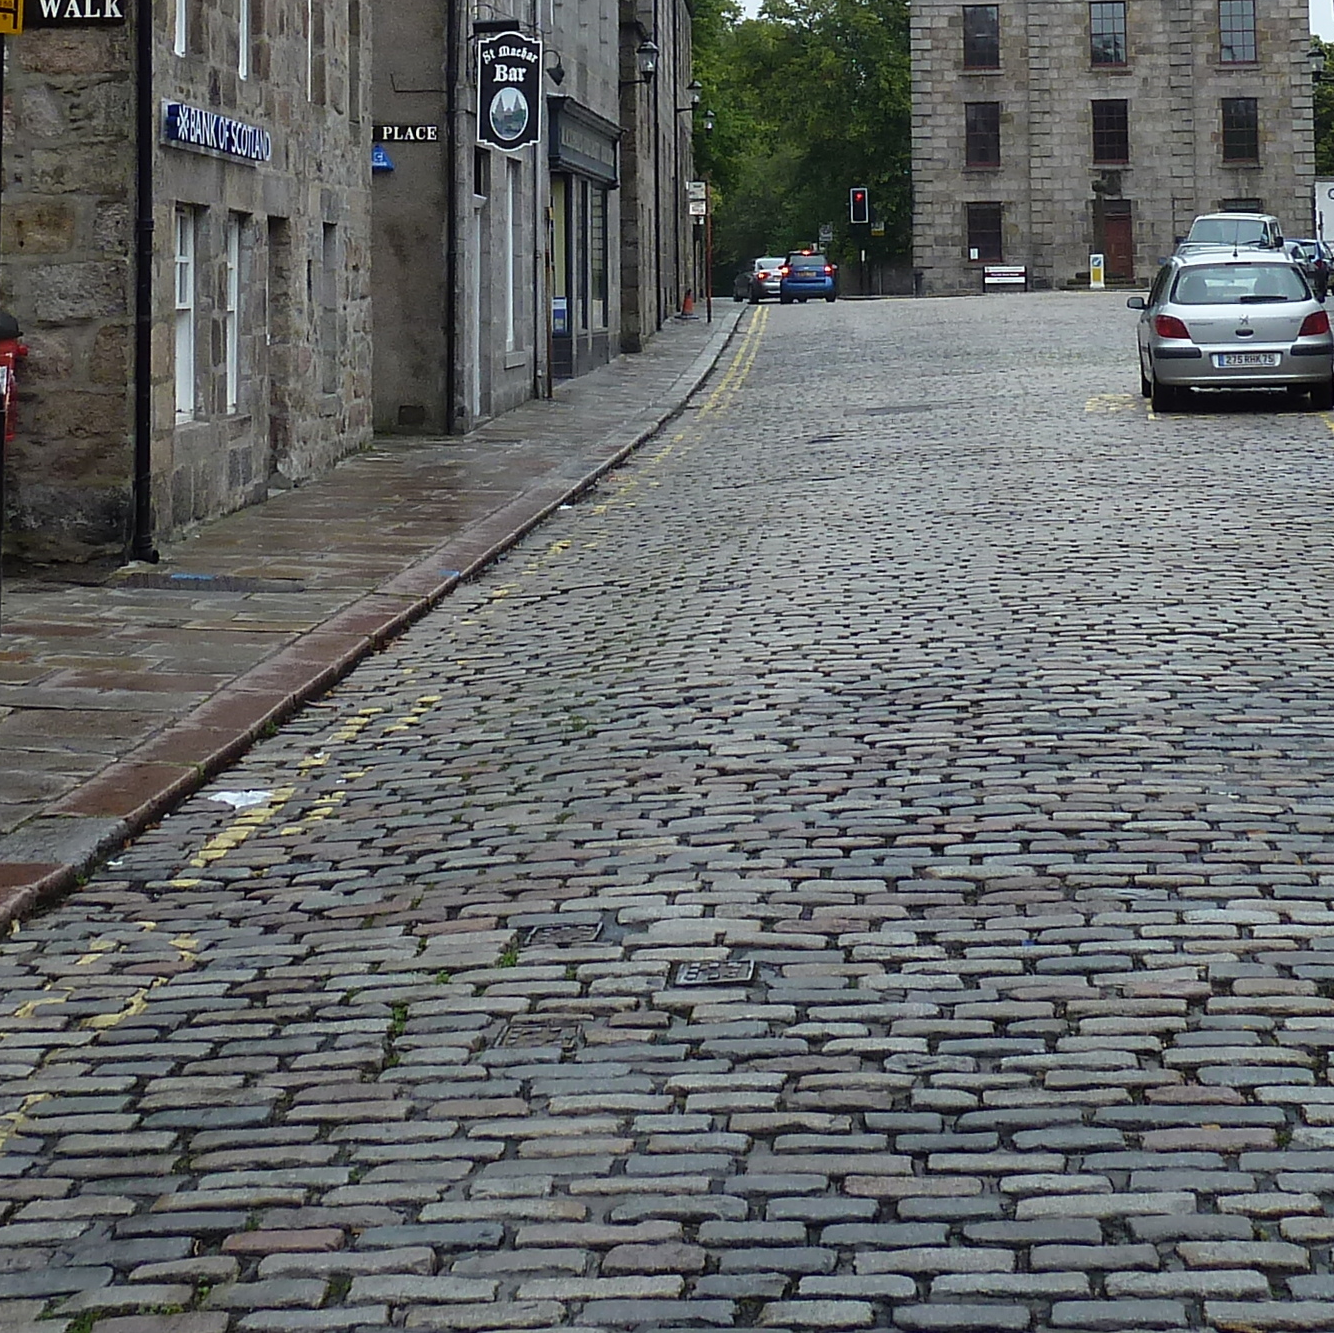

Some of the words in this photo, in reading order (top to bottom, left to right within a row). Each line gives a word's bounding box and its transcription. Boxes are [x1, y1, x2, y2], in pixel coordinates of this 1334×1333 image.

[482, 47, 495, 65] St
[498, 45, 539, 64] Machar
[493, 64, 527, 82] Bar
[190, 107, 217, 149] BANK
[218, 116, 230, 152] OF
[230, 120, 272, 162] SCOTLAND
[382, 126, 438, 141] PLACE
[1225, 354, 1243, 364] 275
[1262, 353, 1274, 363] 75
